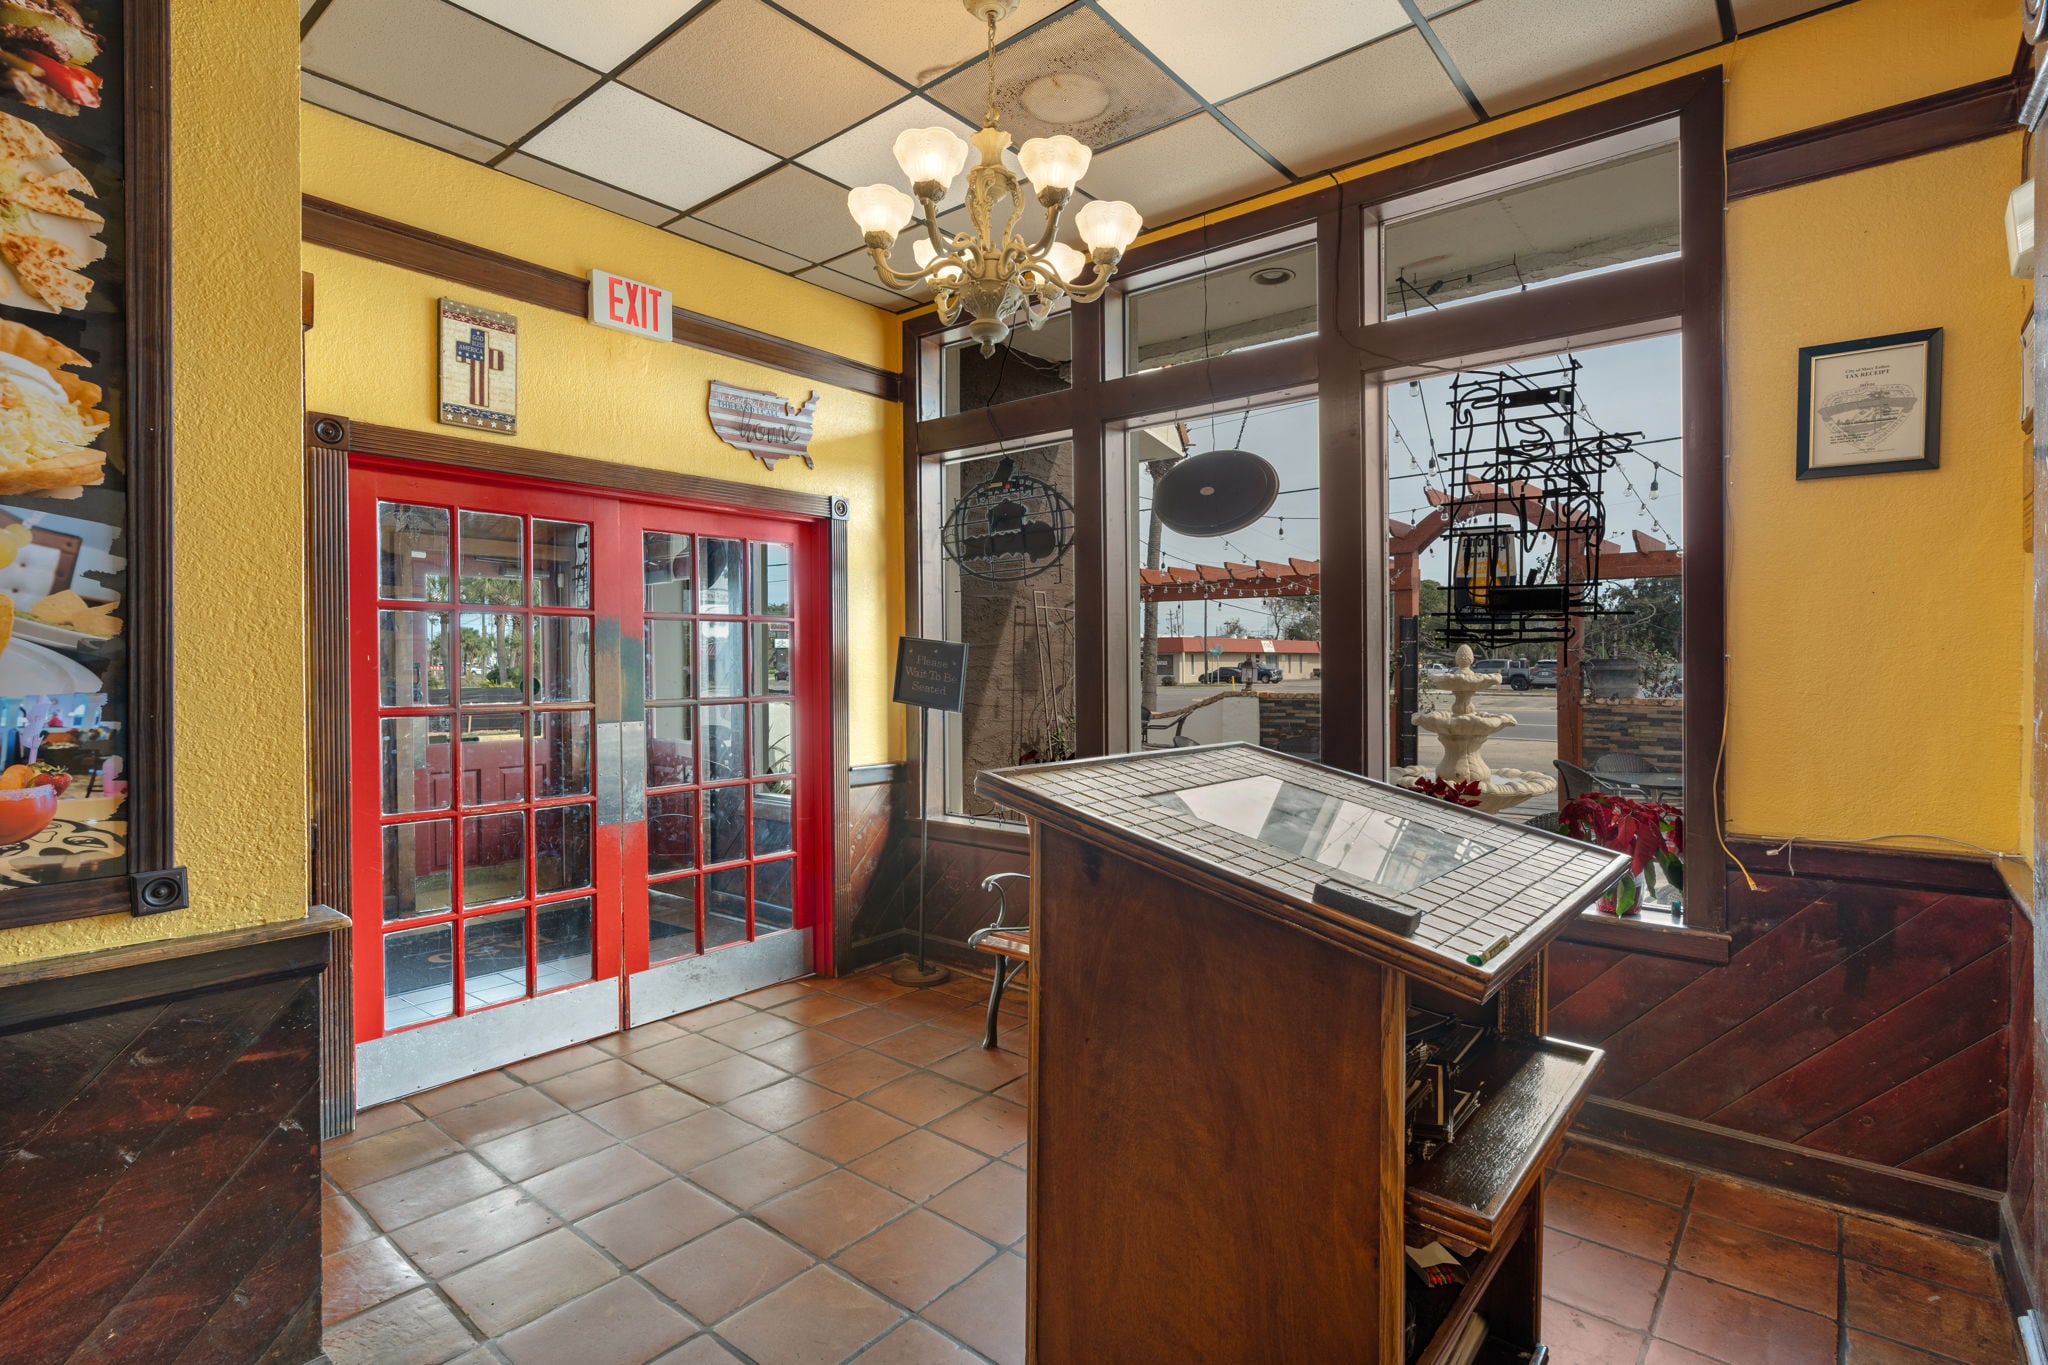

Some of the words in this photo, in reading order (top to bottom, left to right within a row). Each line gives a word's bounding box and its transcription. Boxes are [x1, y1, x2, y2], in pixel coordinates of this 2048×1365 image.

[608, 276, 662, 333] EXIT
[458, 344, 483, 354] AMERICA
[1860, 369, 1890, 377] RECEIPT
[917, 655, 948, 669] Please
[905, 665, 927, 679] Wait
[929, 670, 941, 681] To
[911, 680, 947, 696] Seated
